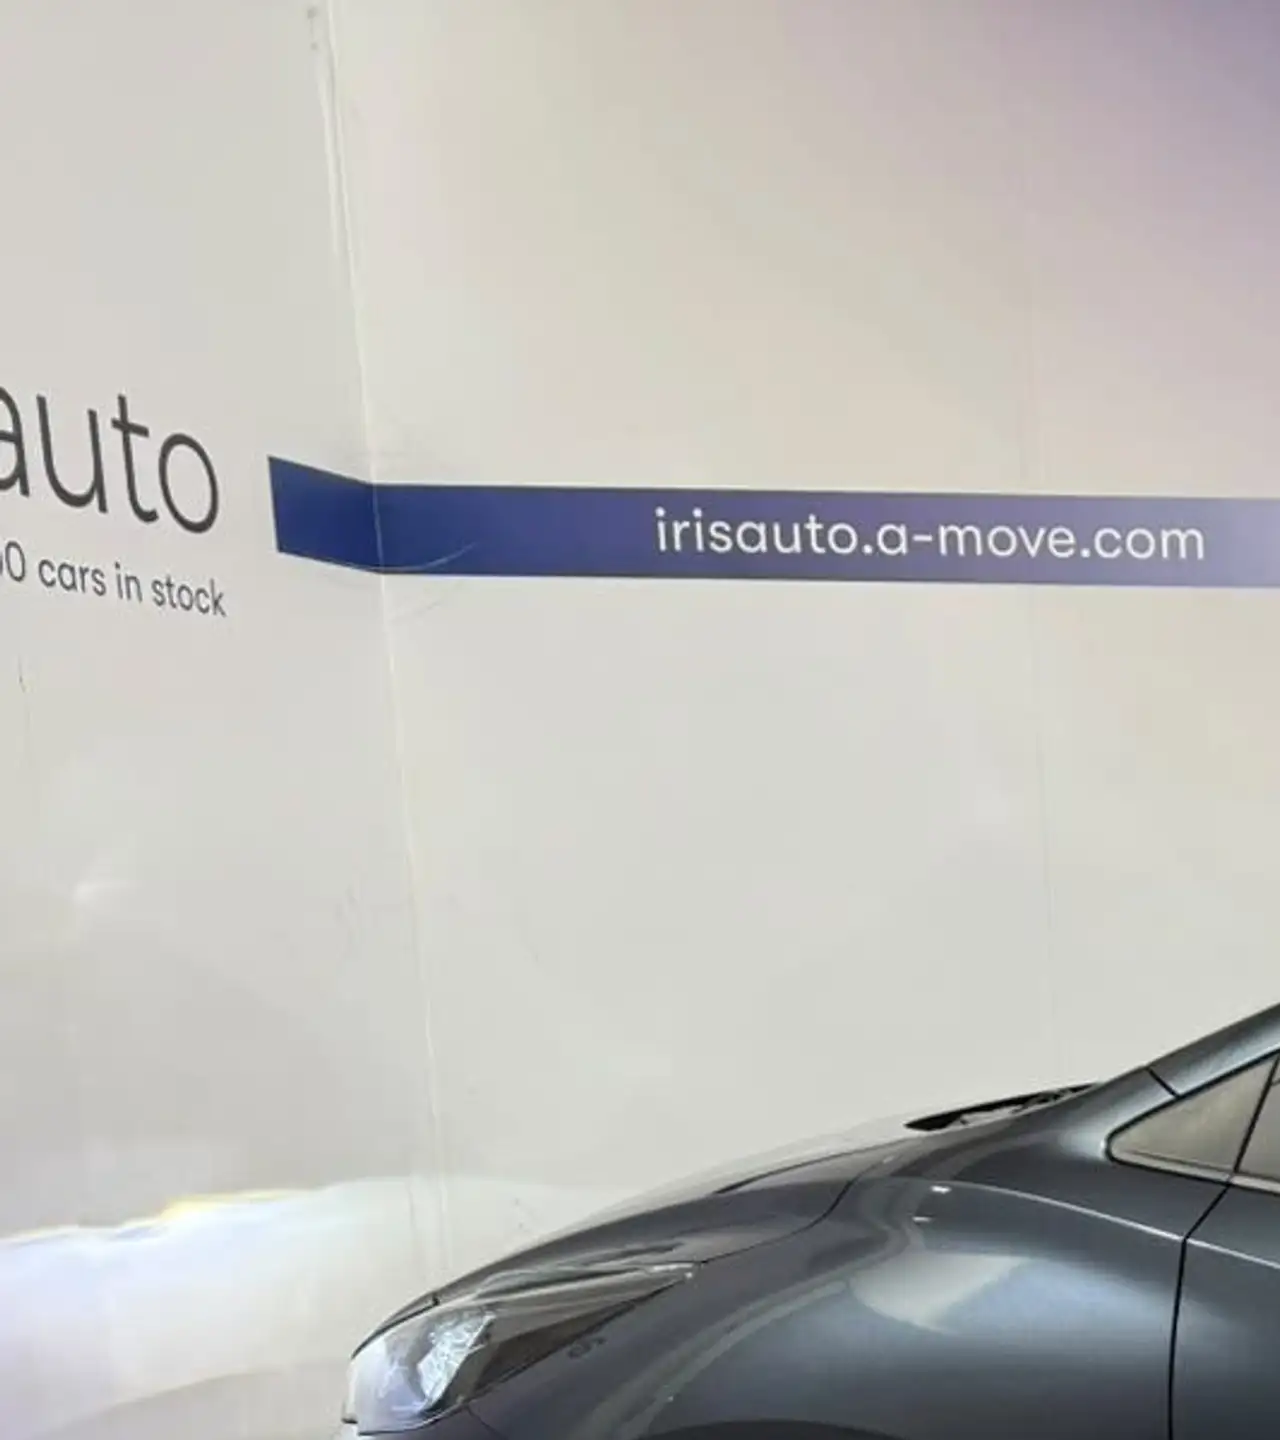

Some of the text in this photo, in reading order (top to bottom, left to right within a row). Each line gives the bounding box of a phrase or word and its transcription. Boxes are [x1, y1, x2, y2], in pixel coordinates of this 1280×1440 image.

[654, 506, 1206, 562] irisauto.a-move.com
[38, 557, 107, 597] cars
[114, 560, 144, 603] in
[151, 574, 227, 618] stock
